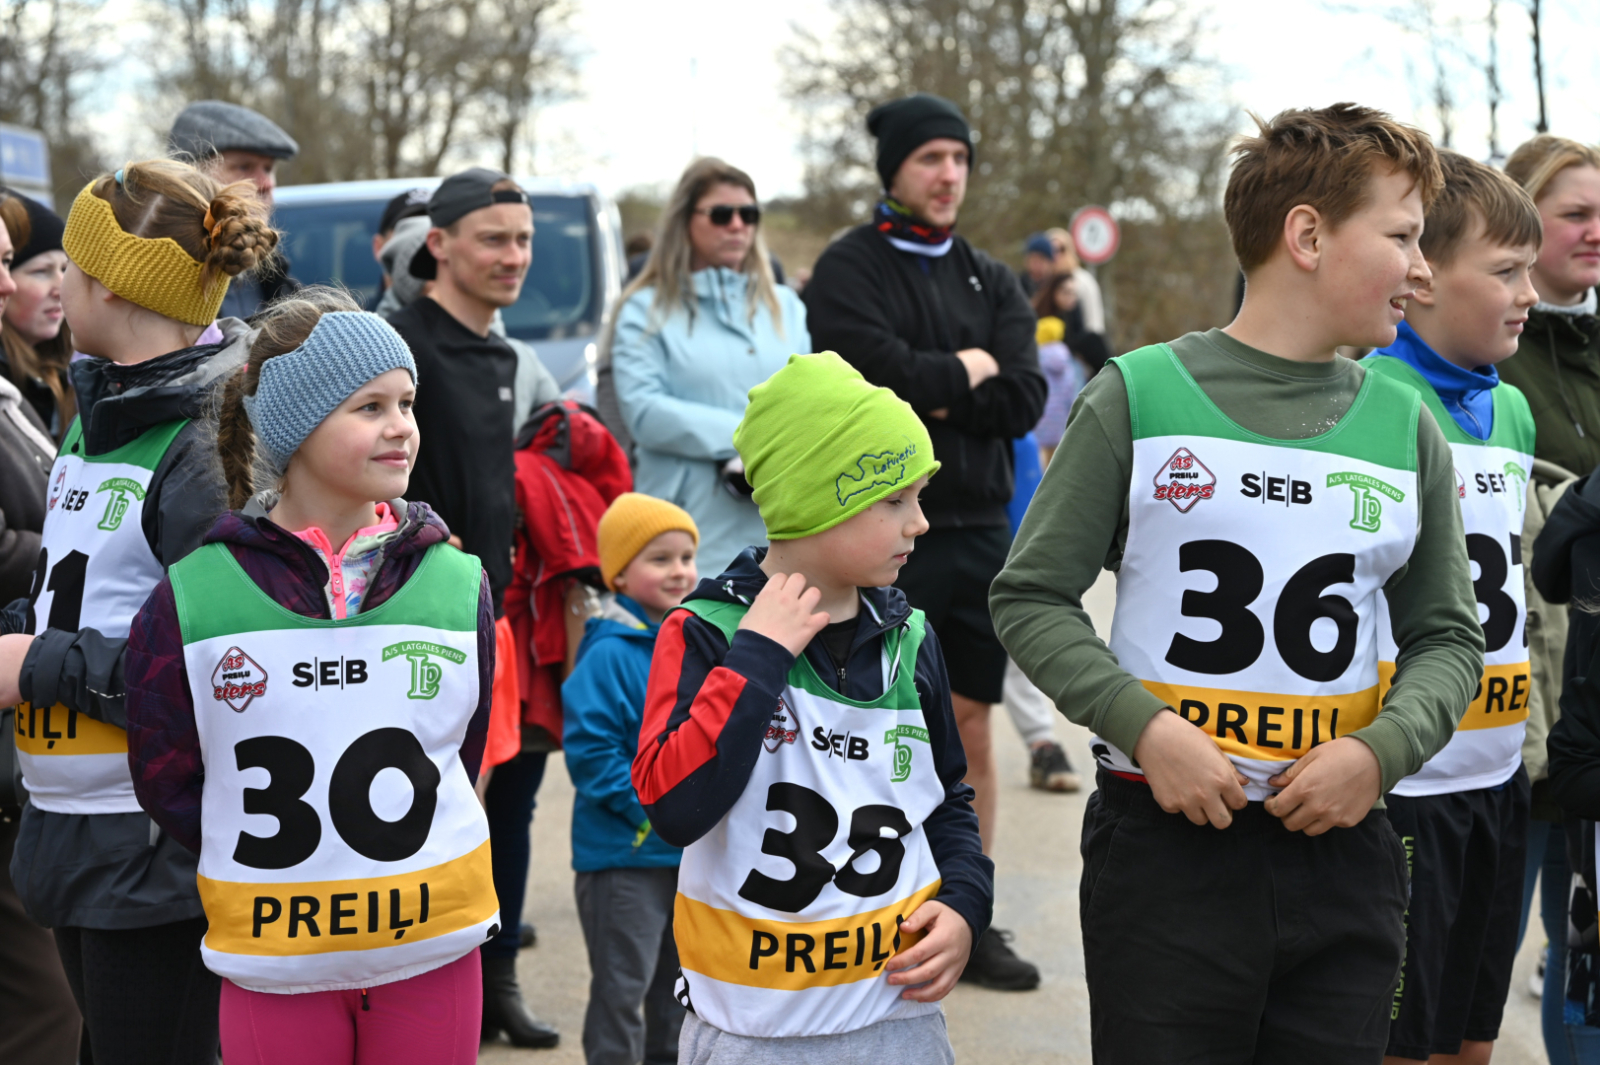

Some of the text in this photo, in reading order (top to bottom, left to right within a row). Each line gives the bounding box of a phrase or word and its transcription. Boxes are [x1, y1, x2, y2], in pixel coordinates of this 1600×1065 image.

[1171, 455, 1193, 471] AS
[1153, 481, 1215, 500] siers
[1329, 474, 1402, 500] A/S LATGALES PIENS
[1165, 539, 1359, 682] 36
[1465, 532, 1529, 652] 3
[223, 654, 245, 672] AS
[385, 643, 464, 662] A/S LATGALES PIENS
[213, 681, 267, 701] siers
[233, 727, 441, 870] 30
[738, 782, 913, 913] 38
[252, 882, 429, 940] PREIĻI
[749, 914, 905, 974] PREIĻI
